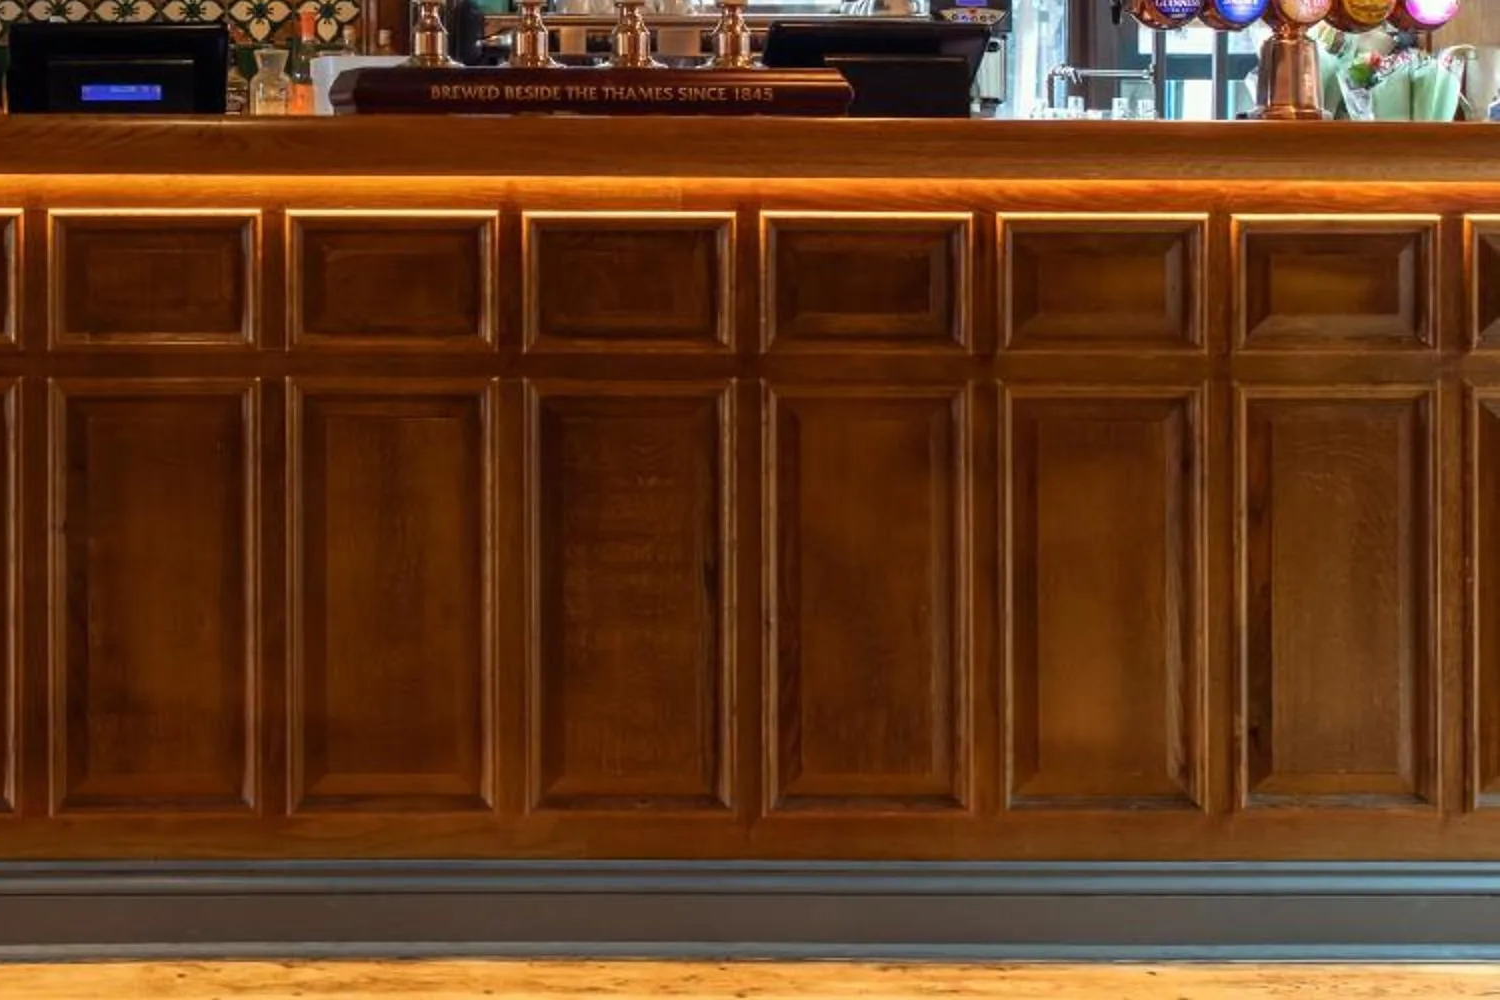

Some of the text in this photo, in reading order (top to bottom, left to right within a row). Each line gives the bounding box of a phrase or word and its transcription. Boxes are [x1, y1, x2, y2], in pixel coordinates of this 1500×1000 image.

[430, 84, 773, 101] BREWED BESIDE THE THAMES SINCE 1845
